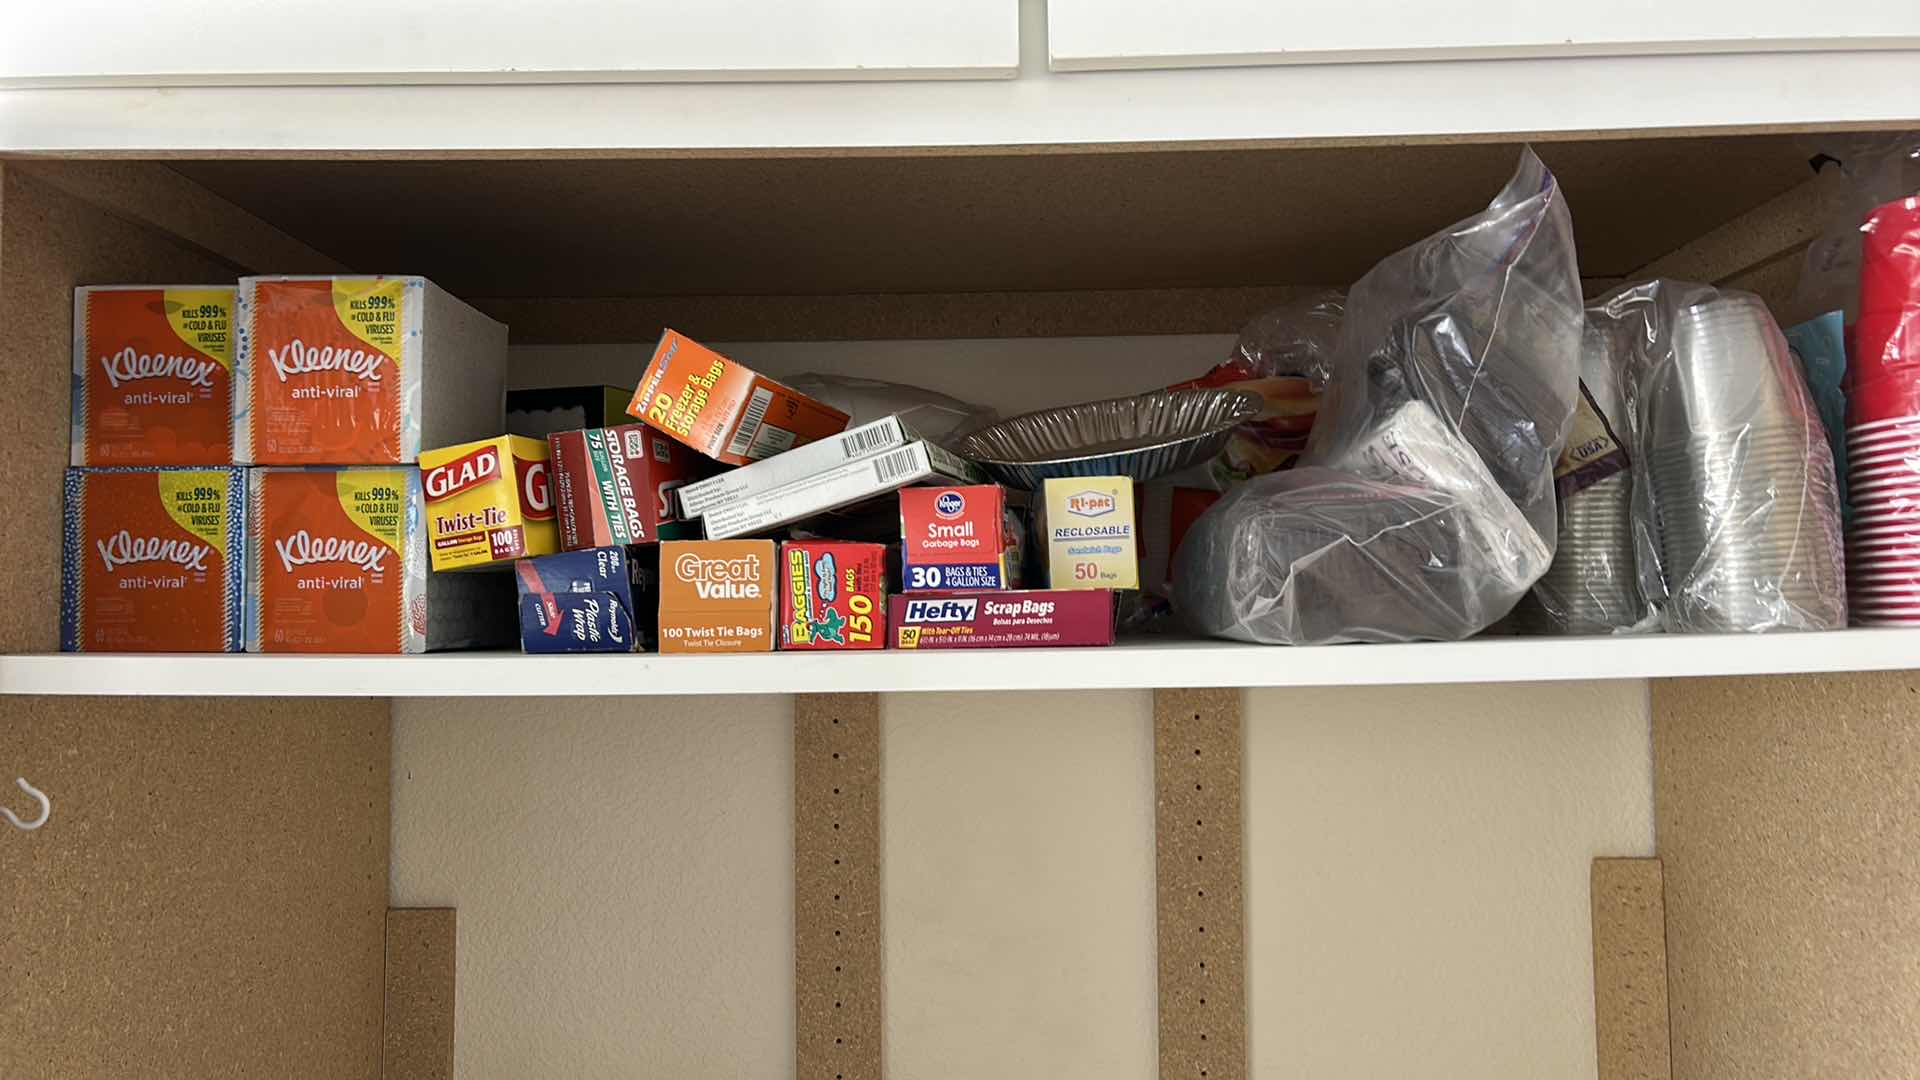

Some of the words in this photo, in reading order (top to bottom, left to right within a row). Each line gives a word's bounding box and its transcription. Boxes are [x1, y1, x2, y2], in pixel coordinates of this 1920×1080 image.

[182, 308, 198, 318] KILLS
[350, 300, 367, 310] KILLS
[189, 321, 206, 330] COLD
[207, 321, 213, 330] &
[214, 320, 227, 330] FLU
[357, 311, 375, 322] COLD
[376, 312, 382, 322] &
[383, 311, 395, 322] FLU
[197, 332, 226, 342] VIRUSES
[365, 324, 394, 335] VIRUSES
[101, 347, 216, 388] Kleenex
[268, 339, 385, 383] Kleenex
[665, 382, 698, 431] Freezer
[688, 373, 701, 385] &
[676, 387, 708, 437] Storage
[702, 359, 724, 390] Bags
[648, 392, 673, 424] 20
[588, 434, 603, 449] 75
[426, 452, 496, 497] GLAD
[605, 429, 634, 497] STORAGE
[622, 497, 645, 539] BAGS
[176, 491, 193, 500] KILLS
[354, 491, 371, 500] KILLS
[939, 496, 961, 512] Kroger
[182, 503, 200, 513] COLD
[201, 503, 207, 513] &
[208, 503, 220, 513] FLU
[361, 503, 379, 513] COLD
[379, 503, 385, 513] &
[386, 502, 399, 513] FLU
[601, 480, 617, 511] WITH
[611, 514, 627, 539] TIES
[191, 515, 220, 526] VIRUSES
[369, 515, 398, 526] VIRUSES
[436, 507, 506, 534] Twist-Tie
[928, 521, 973, 537] Small
[491, 530, 512, 546] 100
[1055, 525, 1130, 537] RECLOSABLE
[97, 530, 209, 573] Kleenex
[275, 530, 388, 573] Kleenex
[922, 540, 959, 549] Garbage
[960, 539, 980, 547] Bags
[597, 551, 607, 579] Clear
[675, 553, 760, 582] Great
[946, 567, 964, 577] BAGS
[966, 567, 971, 577] &
[973, 567, 987, 576] TIES
[1075, 563, 1097, 580] 50
[846, 568, 855, 592] BAGS
[912, 567, 941, 587] 30
[945, 577, 950, 586] 4
[951, 577, 980, 586] GALLON
[981, 577, 996, 586] SIZE
[695, 580, 760, 599] Value
[790, 549, 810, 643] BAGGIES
[608, 599, 619, 635] Reynolds
[909, 601, 974, 621] Hefty
[984, 601, 1022, 617] Scrap
[1022, 600, 1055, 617] Bags
[572, 608, 586, 641] Wrap
[584, 599, 601, 643] Plastic
[849, 595, 873, 642] 150
[663, 628, 683, 638] 100
[684, 627, 715, 637] Twist
[716, 627, 734, 636] Tie
[736, 626, 763, 638] Bags
[902, 630, 917, 640] 50
